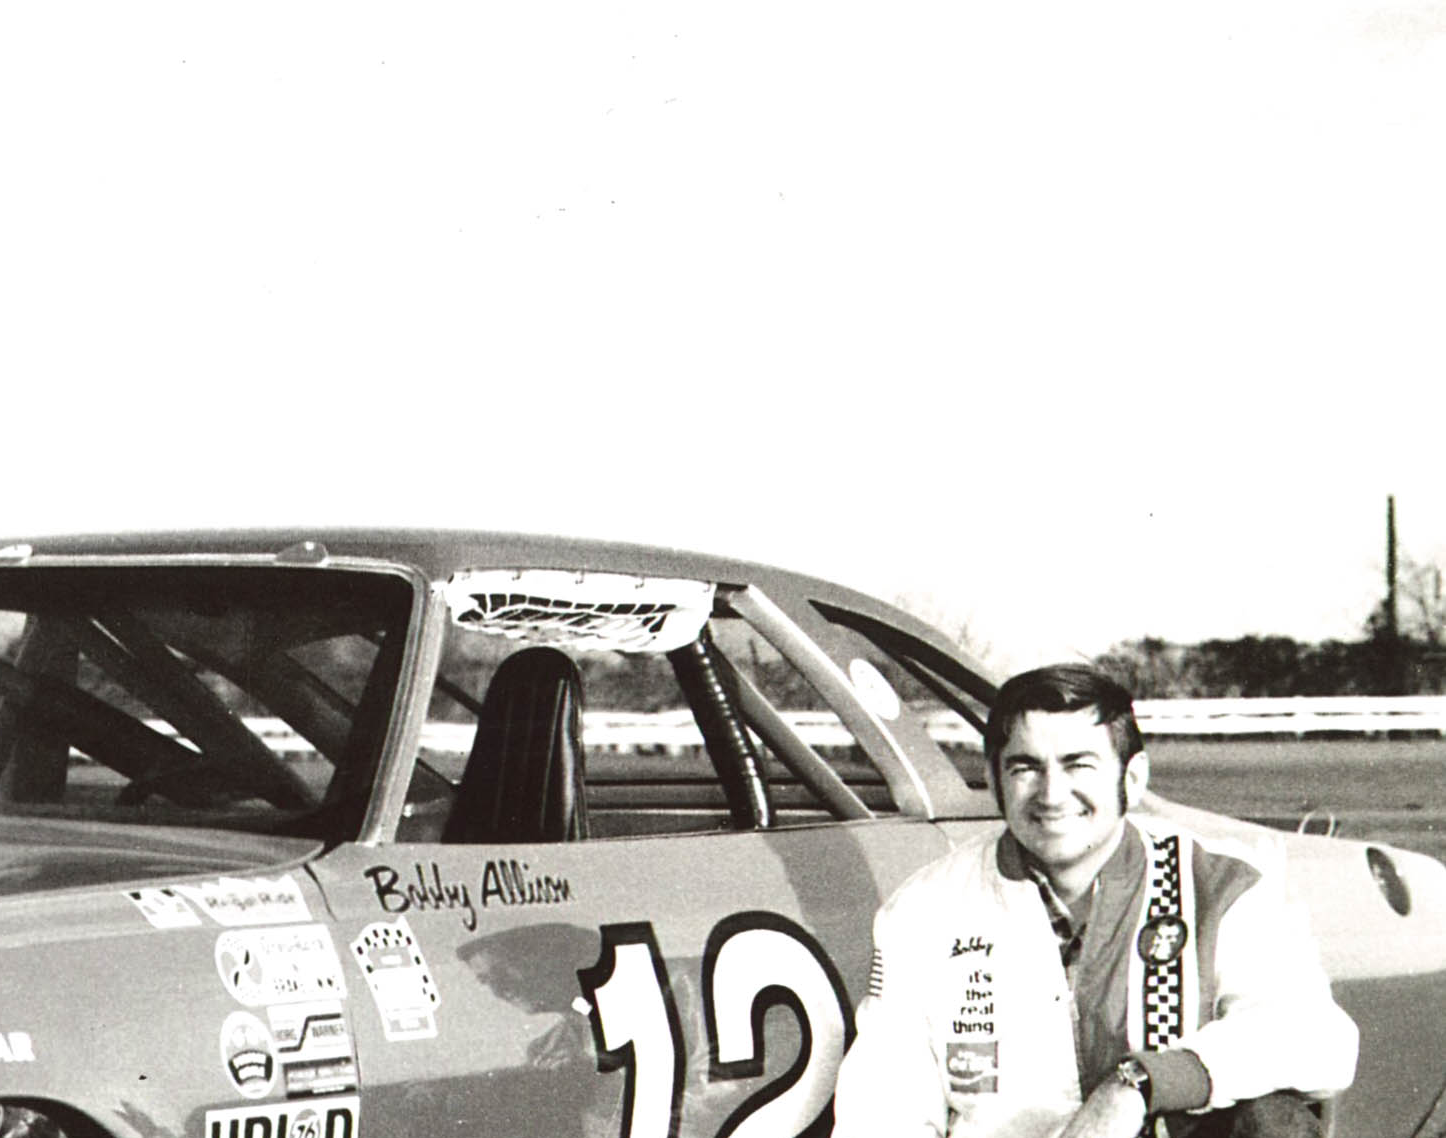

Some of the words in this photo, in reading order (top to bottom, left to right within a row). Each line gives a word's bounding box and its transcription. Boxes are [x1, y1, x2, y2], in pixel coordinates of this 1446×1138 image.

[363, 862, 478, 932] Bobby
[481, 859, 576, 908] Allison
[950, 936, 994, 958] Bobby
[968, 969, 993, 984] it's
[965, 988, 993, 1001] the
[960, 1002, 994, 1016] real
[952, 1020, 995, 1036] thing
